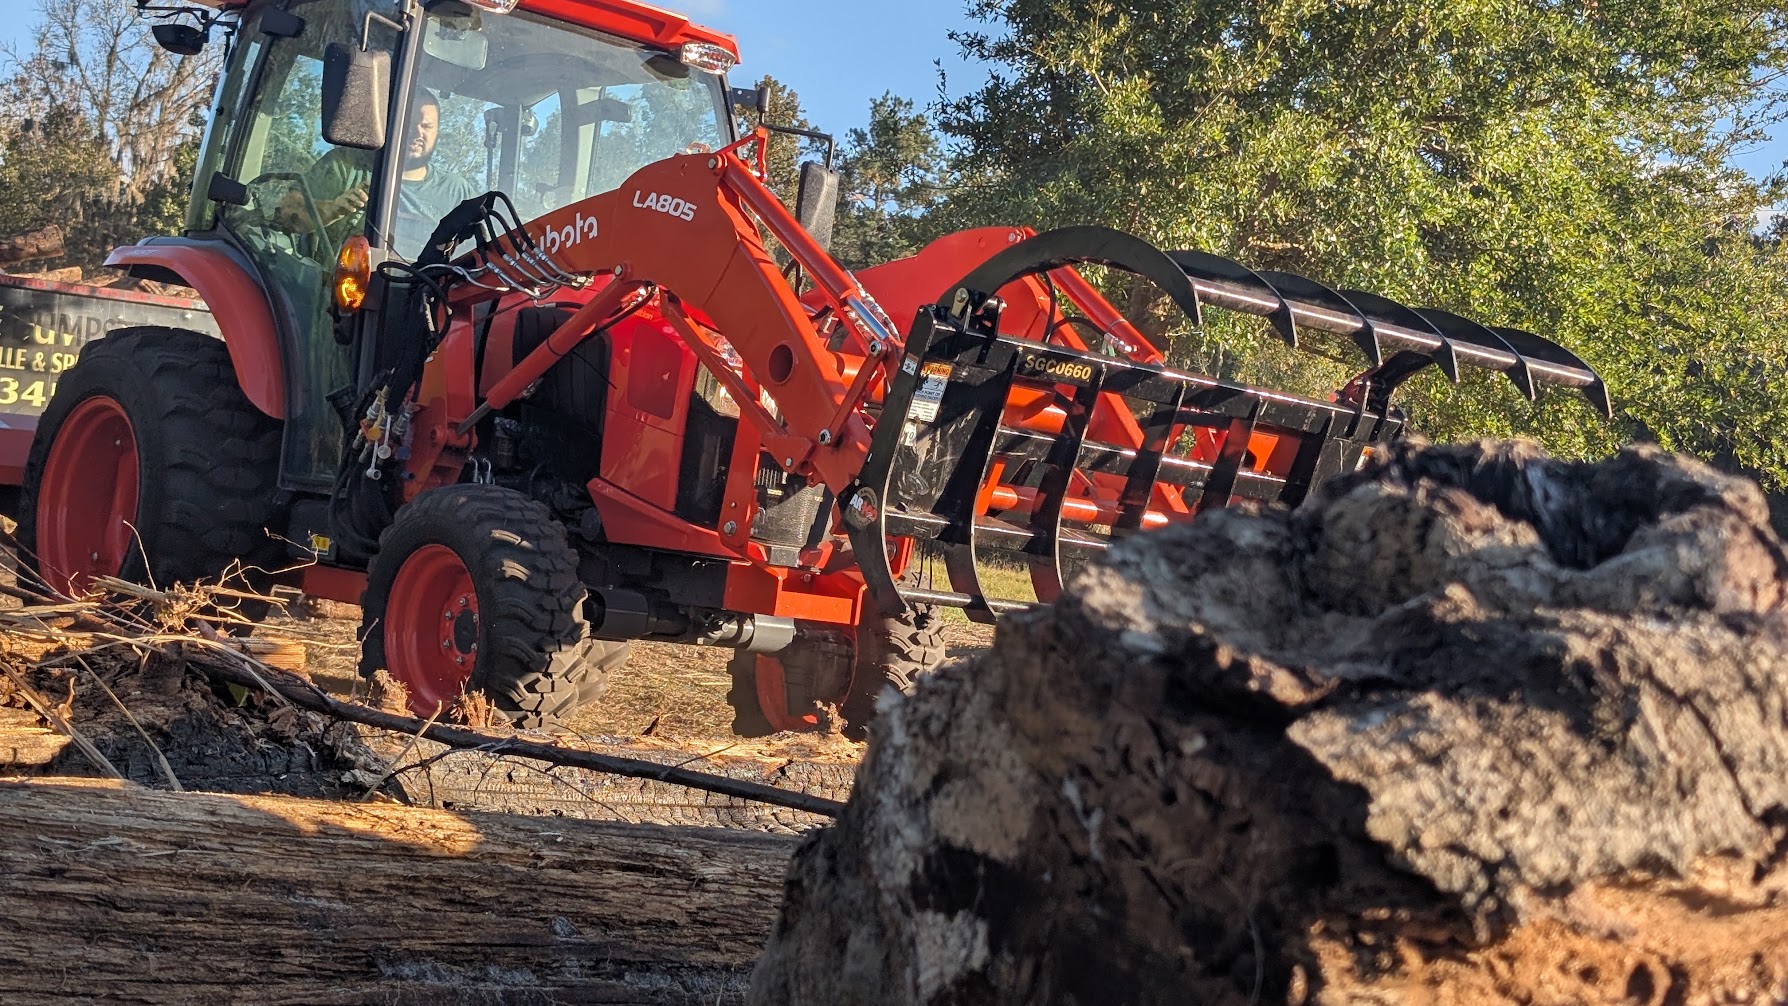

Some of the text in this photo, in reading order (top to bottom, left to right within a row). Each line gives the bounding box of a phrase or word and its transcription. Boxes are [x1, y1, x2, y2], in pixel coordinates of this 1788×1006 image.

[632, 190, 697, 222] LA805
[32, 351, 46, 372] &
[50, 352, 79, 373] SP
[1024, 354, 1092, 380] SGC0660
[0, 377, 57, 407] 34
